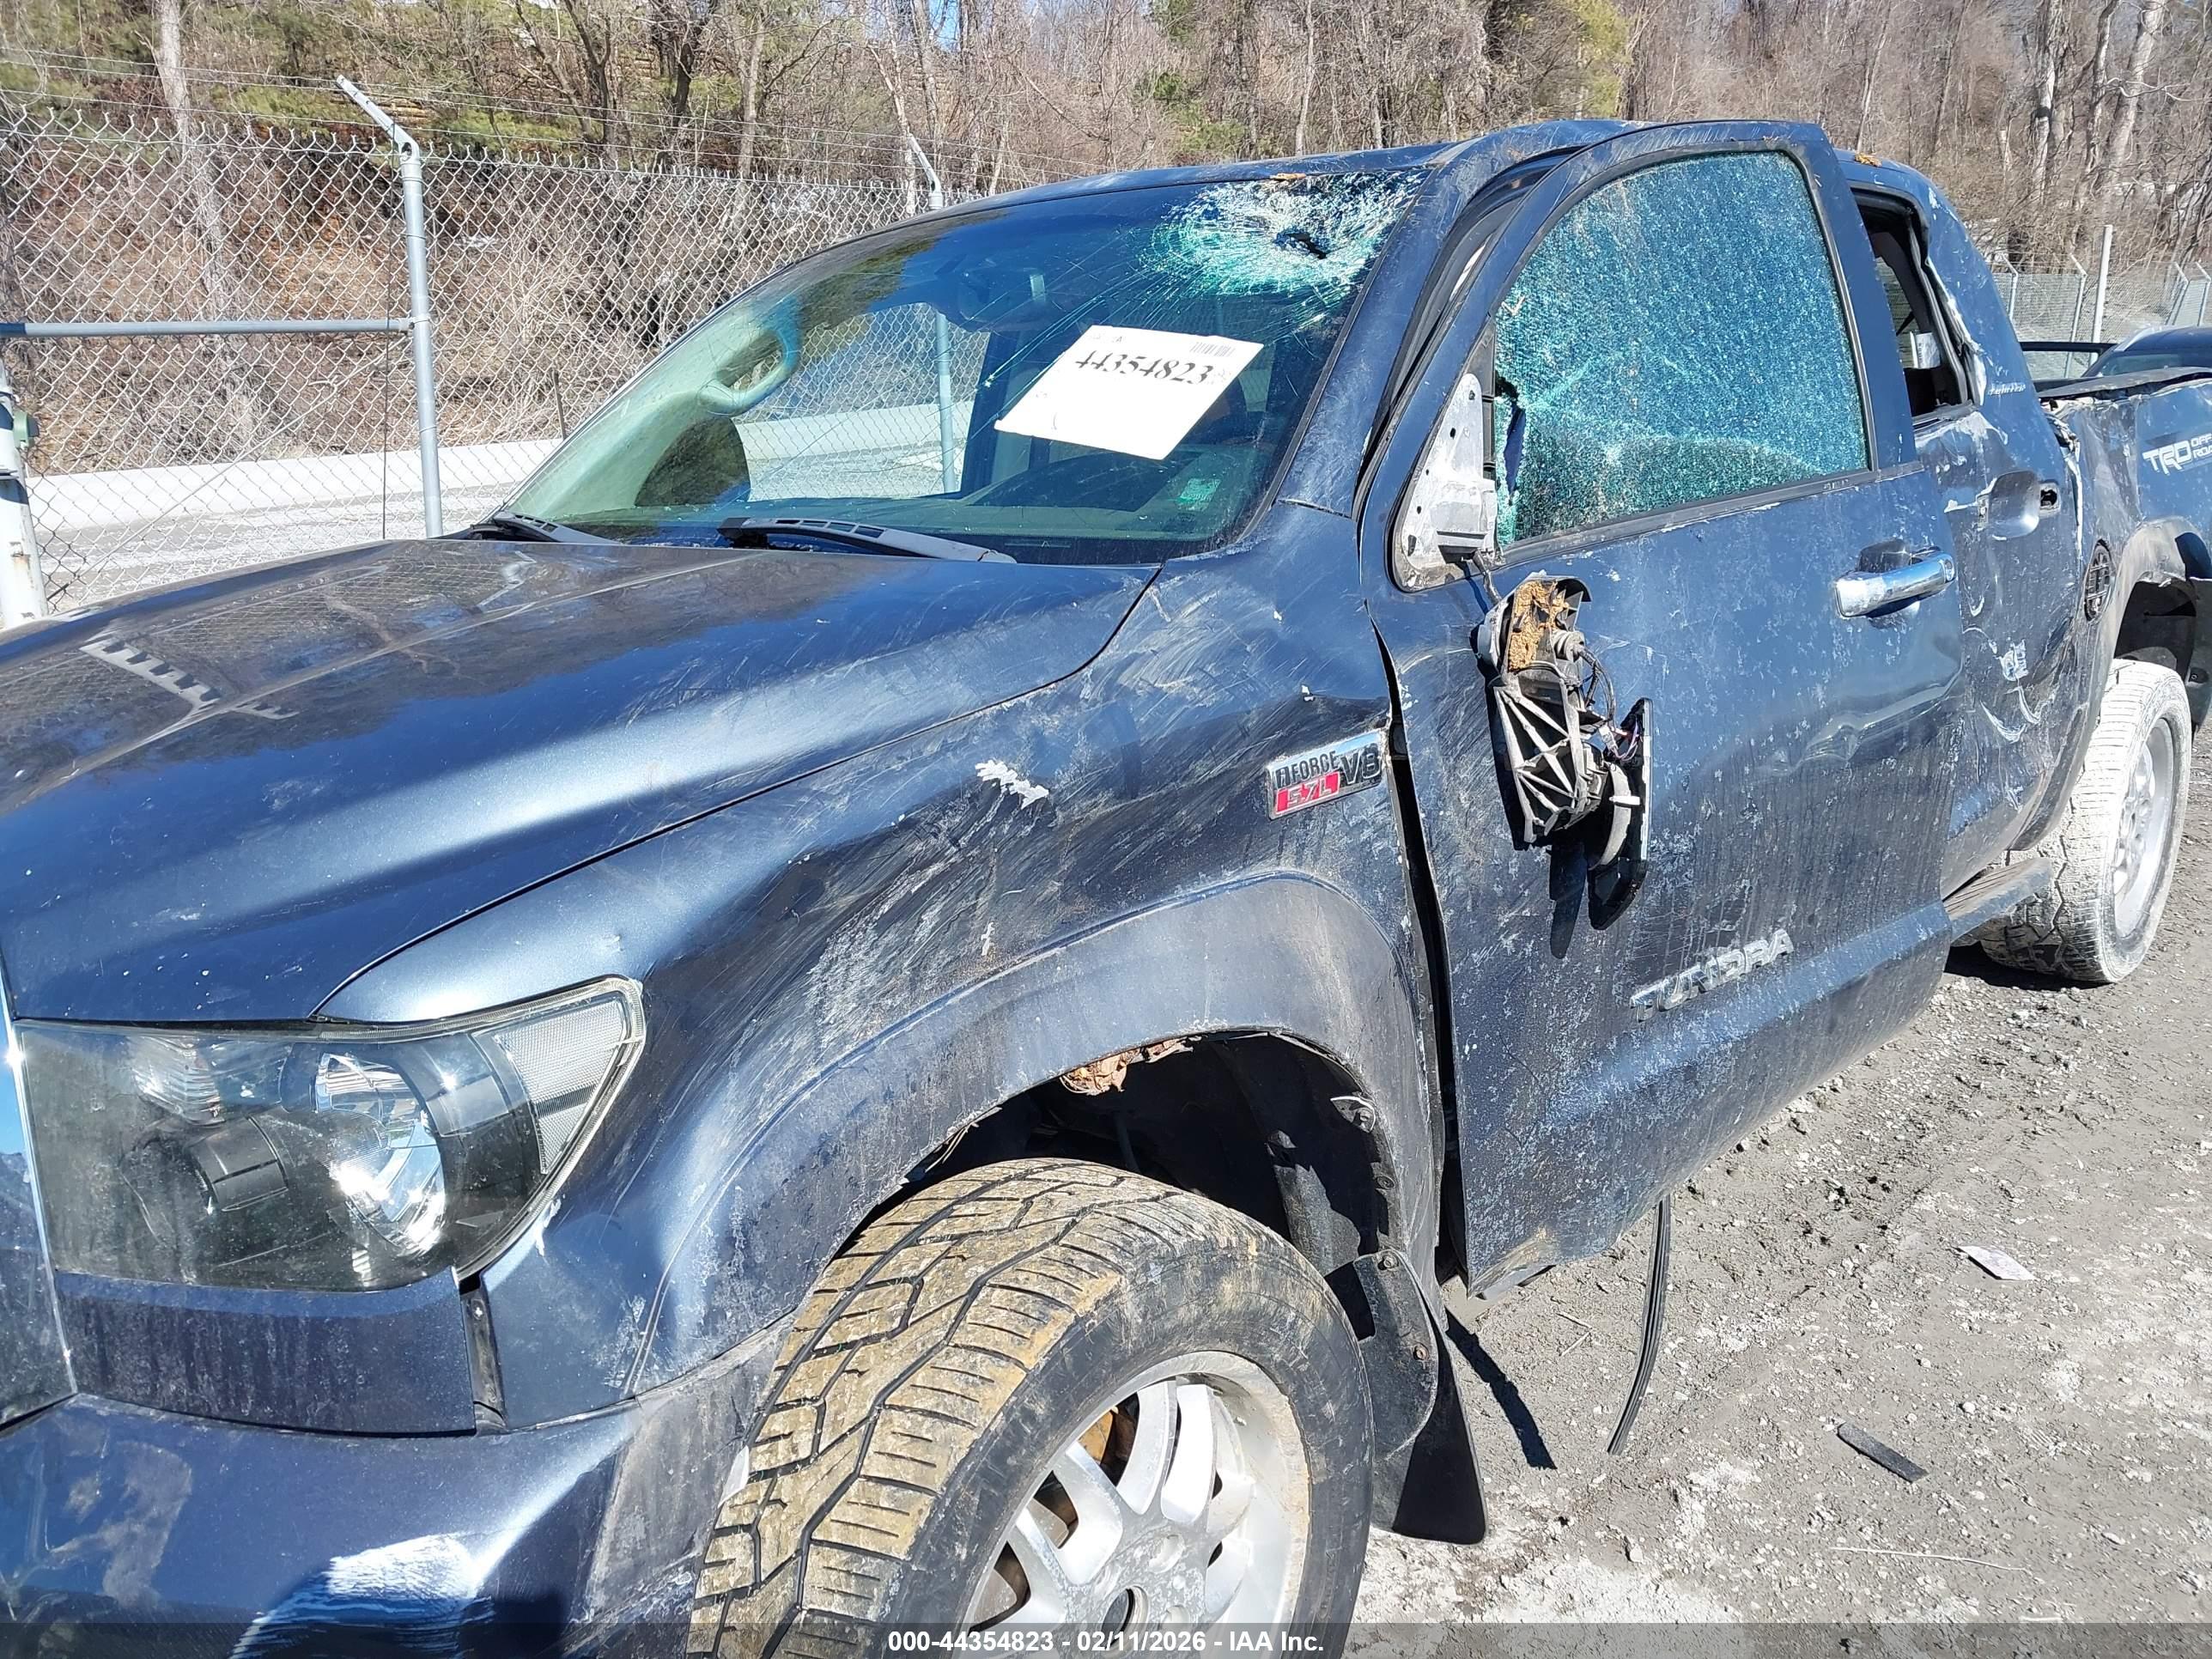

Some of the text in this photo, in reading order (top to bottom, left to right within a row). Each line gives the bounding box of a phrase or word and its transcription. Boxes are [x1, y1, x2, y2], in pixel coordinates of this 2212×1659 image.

[1075, 349, 1213, 385] 44354823
[2142, 441, 2191, 476] TRD
[1340, 743, 1381, 785] V8
[1630, 928, 1794, 1021] TUNDRA
